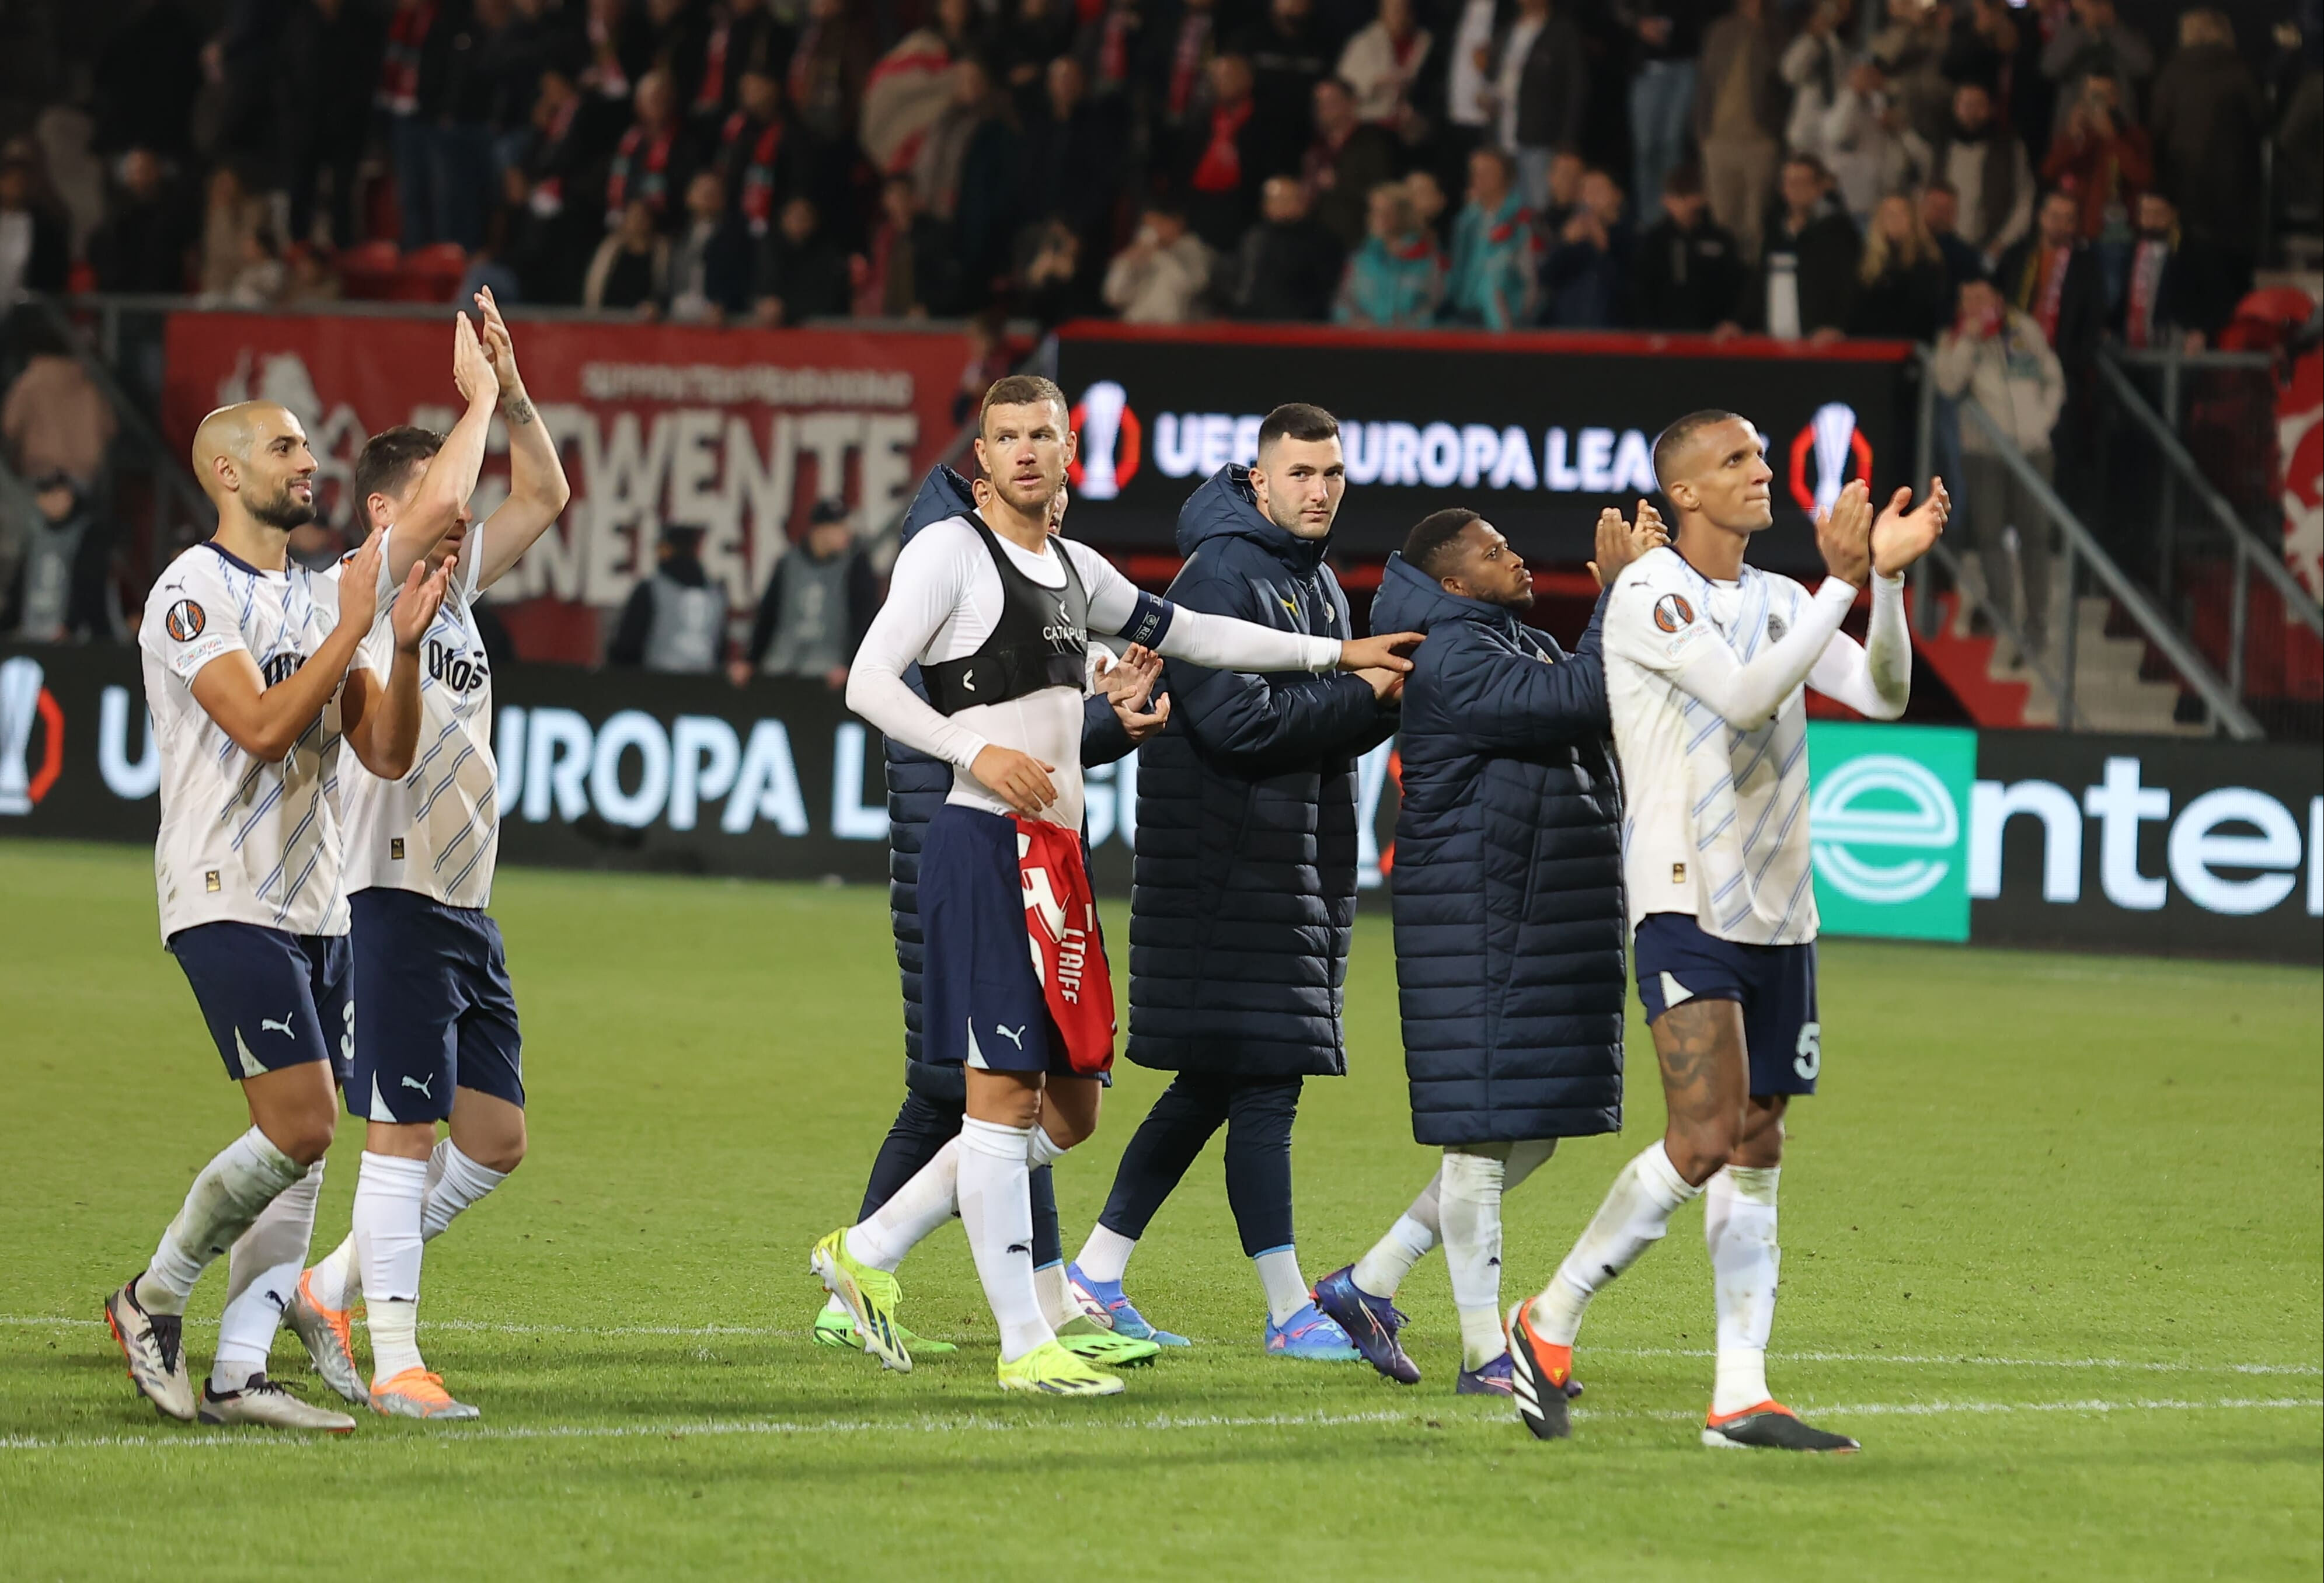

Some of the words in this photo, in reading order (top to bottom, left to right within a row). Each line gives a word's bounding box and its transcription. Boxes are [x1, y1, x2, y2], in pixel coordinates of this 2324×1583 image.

[1154, 411, 1264, 479] UEF
[1339, 419, 1538, 489] UROPA
[1543, 426, 1664, 494] LEA
[496, 705, 810, 836] ROPA
[1793, 1021, 1820, 1080] 5
